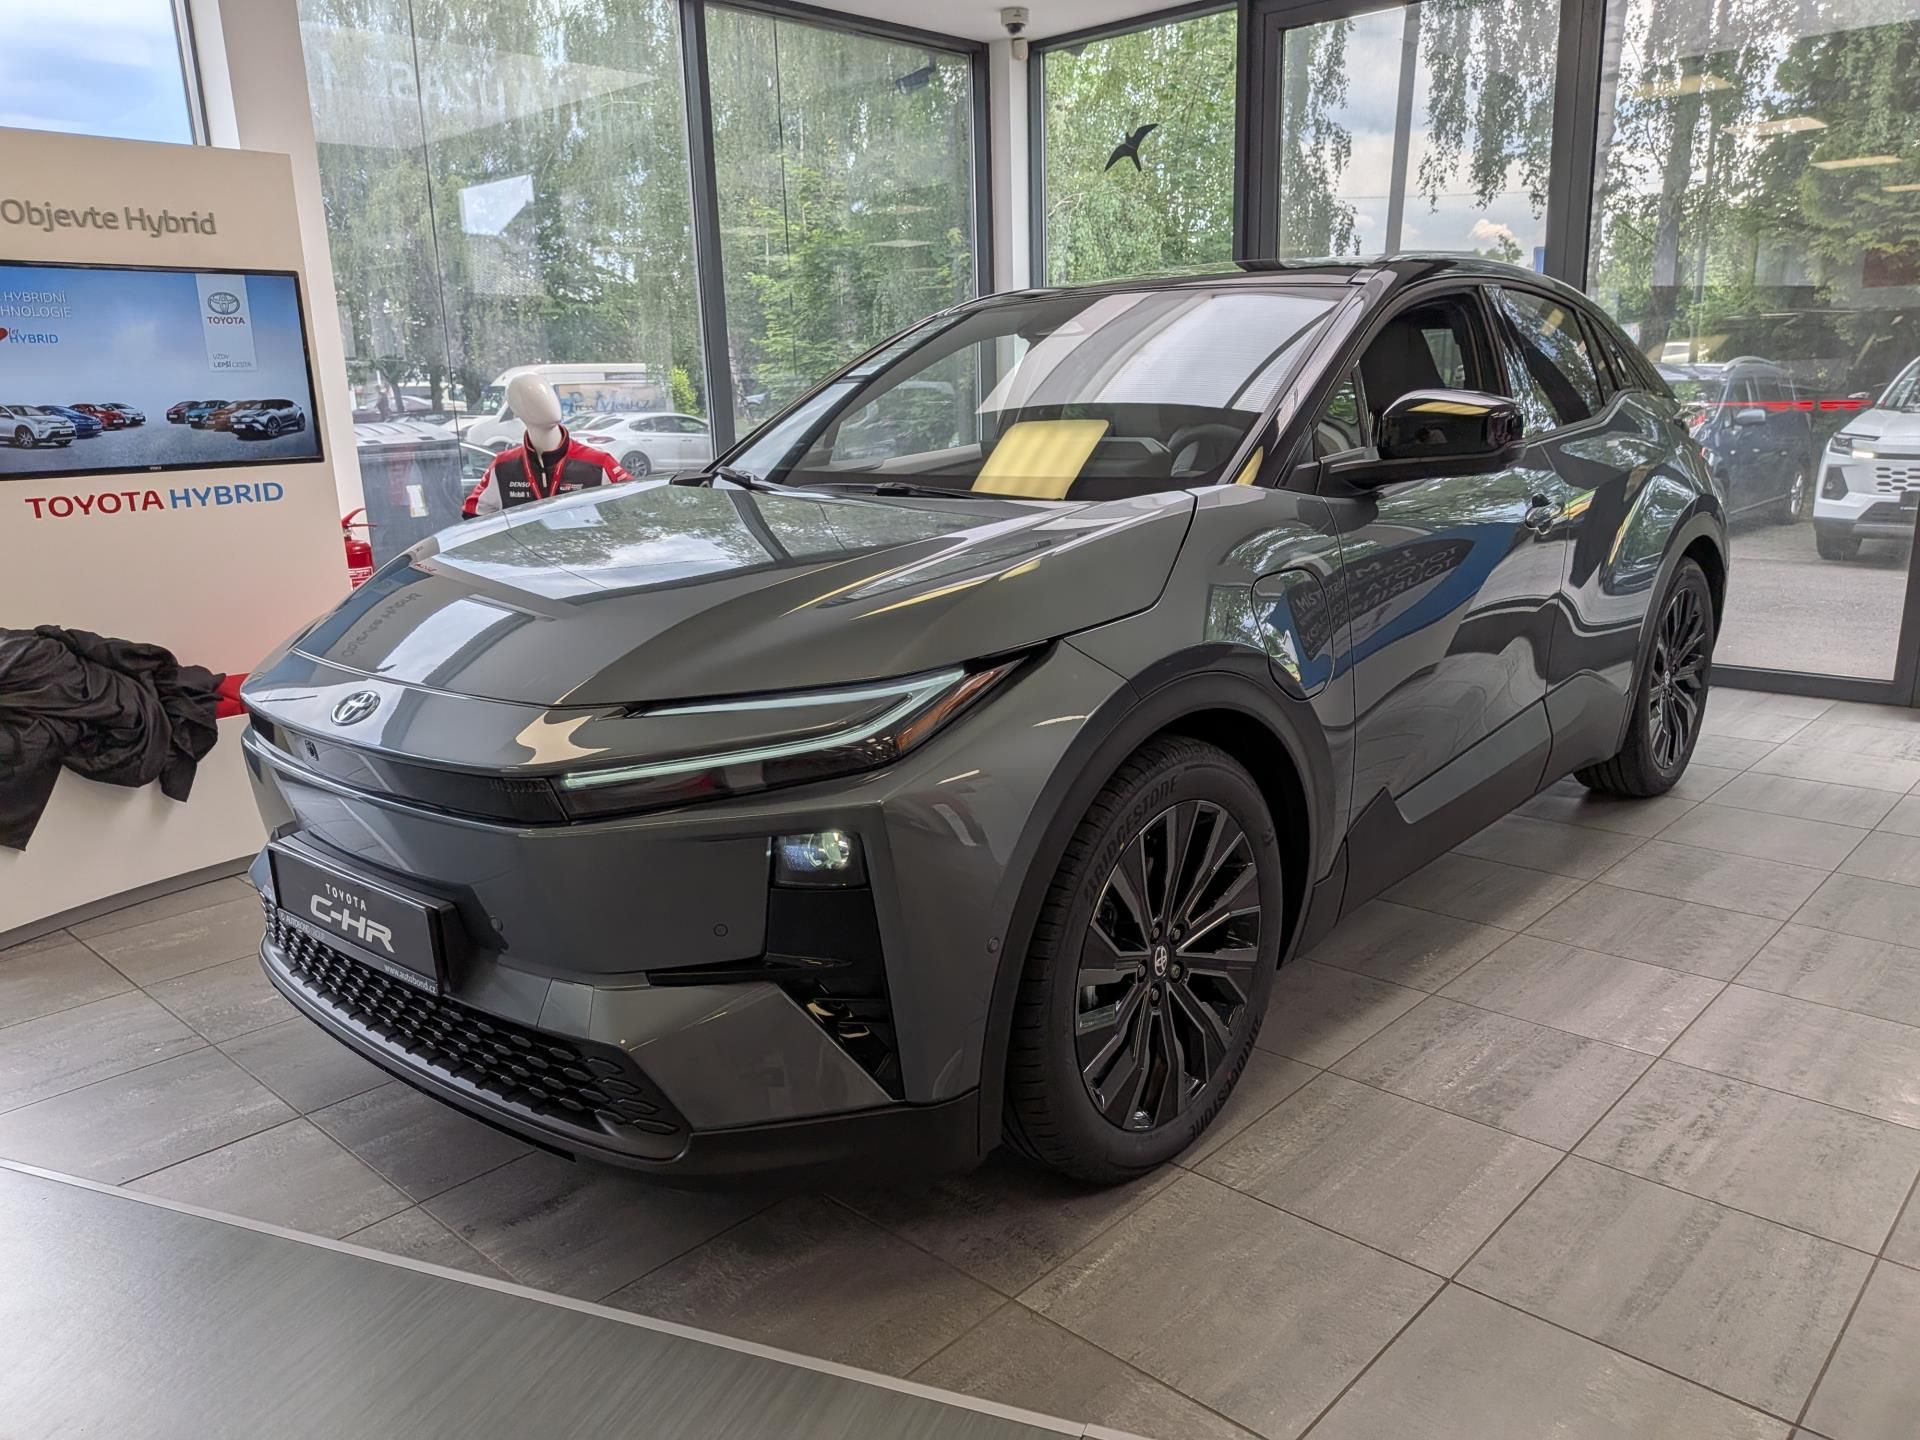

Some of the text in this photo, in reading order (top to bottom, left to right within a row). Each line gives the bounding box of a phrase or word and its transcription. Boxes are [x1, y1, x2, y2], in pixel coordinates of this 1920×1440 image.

[0, 198, 217, 238] Objevte Hybrid
[207, 316, 246, 325] TOYOTA
[9, 334, 59, 344] HYBRID
[24, 482, 284, 519] TOYOTA HYBRID
[325, 882, 367, 911] TOYOTA
[310, 894, 395, 954] C-HR
[383, 963, 437, 994] www.autobond.cz
